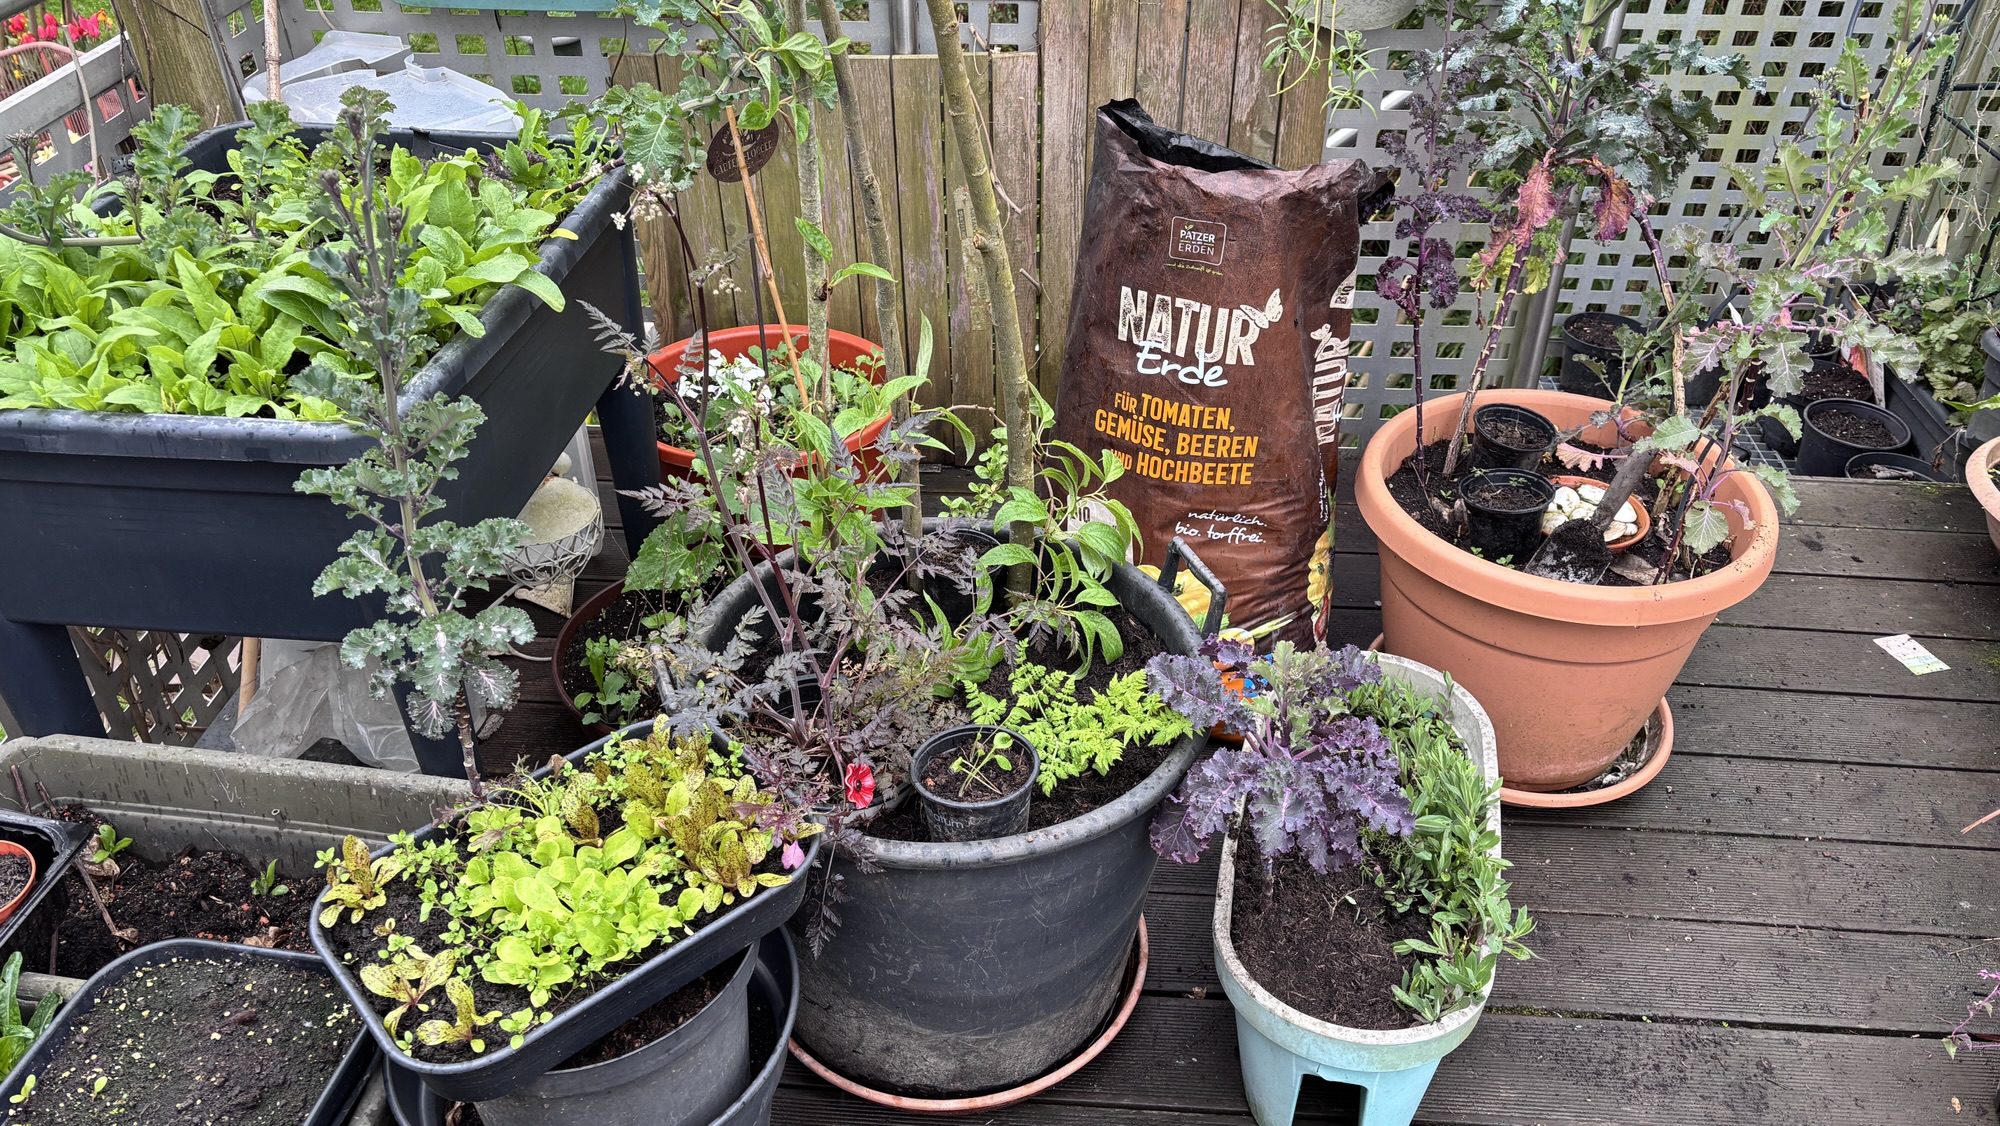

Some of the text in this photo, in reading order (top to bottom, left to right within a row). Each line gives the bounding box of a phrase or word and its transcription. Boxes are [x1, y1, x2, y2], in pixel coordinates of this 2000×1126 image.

[1178, 242, 1215, 256] ERDEN
[1180, 229, 1216, 243] PATZER
[1117, 285, 1261, 366] NATUR
[1136, 340, 1229, 388] Erde
[1114, 390, 1236, 433] FÜR TOMATEN,
[1094, 408, 1259, 459] GEMÜSE, BEEREN
[1135, 451, 1255, 485] HOCHBEETE
[1175, 521, 1267, 545] bio. torffrei.
[1188, 509, 1268, 528] natürlich.
